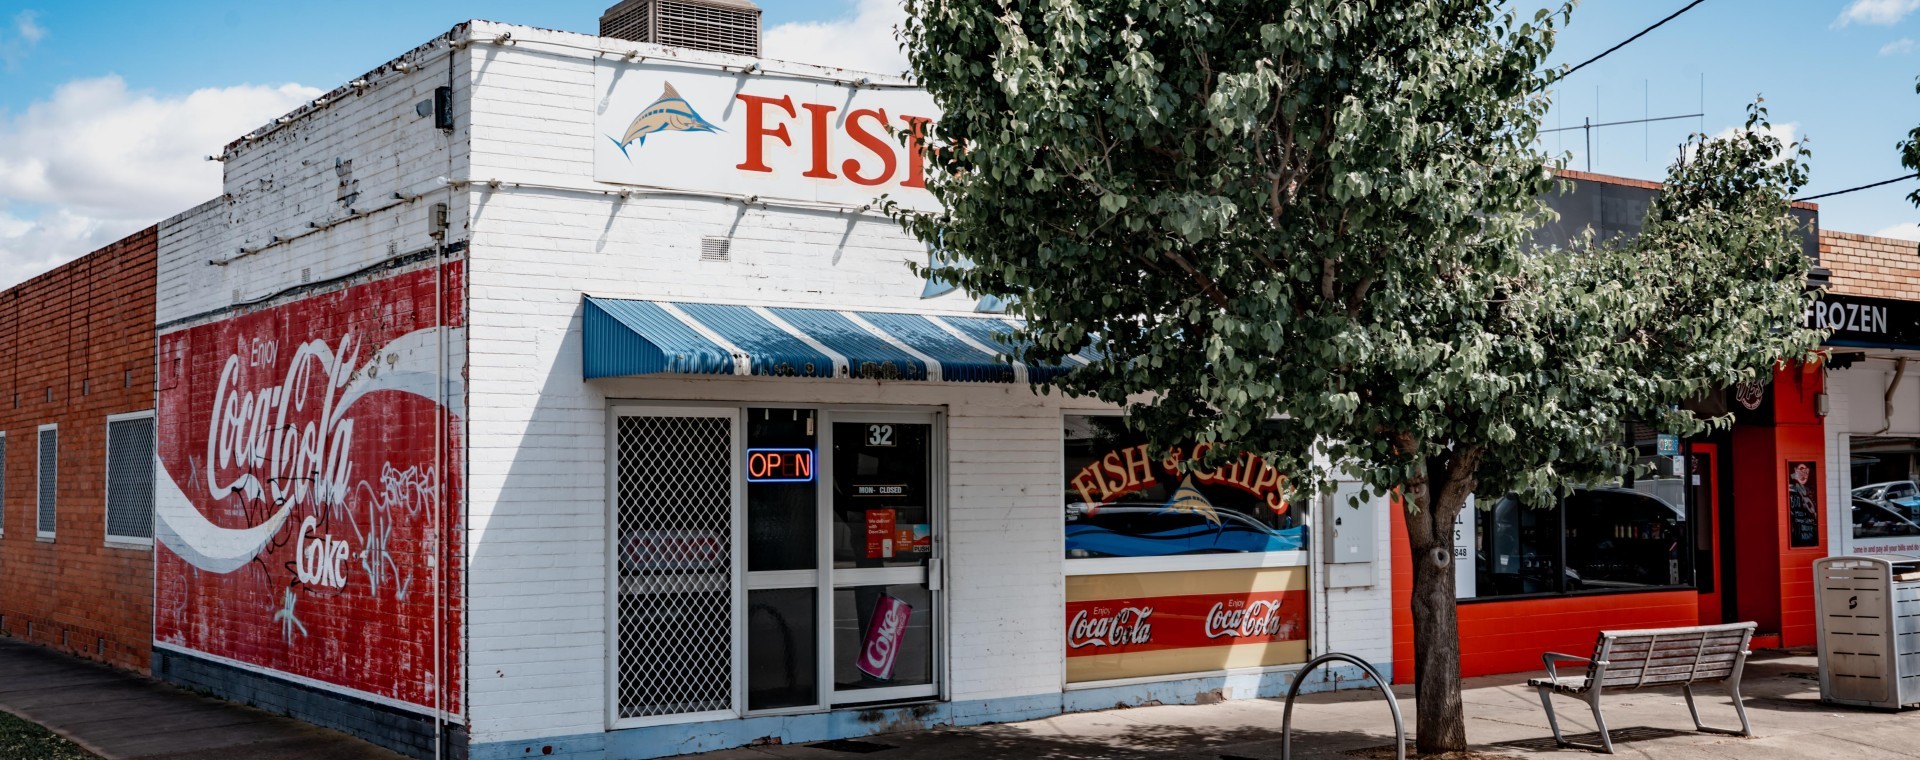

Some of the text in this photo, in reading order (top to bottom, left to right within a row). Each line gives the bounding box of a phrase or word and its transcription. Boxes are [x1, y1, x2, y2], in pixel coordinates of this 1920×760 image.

[1803, 299, 1886, 334] FROZEN
[251, 337, 278, 369] Enjoy
[207, 332, 362, 504] Coca-Cola
[869, 424, 893, 446] 32
[749, 452, 810, 478] OPEN
[1071, 443, 1156, 514] FISH
[879, 485, 902, 494] CLOSED
[296, 515, 350, 588] Coke
[1093, 606, 1111, 616] Enjoy
[1205, 599, 1281, 638] Coca-Cola
[1228, 599, 1245, 608] Enjoy
[867, 609, 899, 669] Coke
[1067, 606, 1153, 649] Coca-Cola
